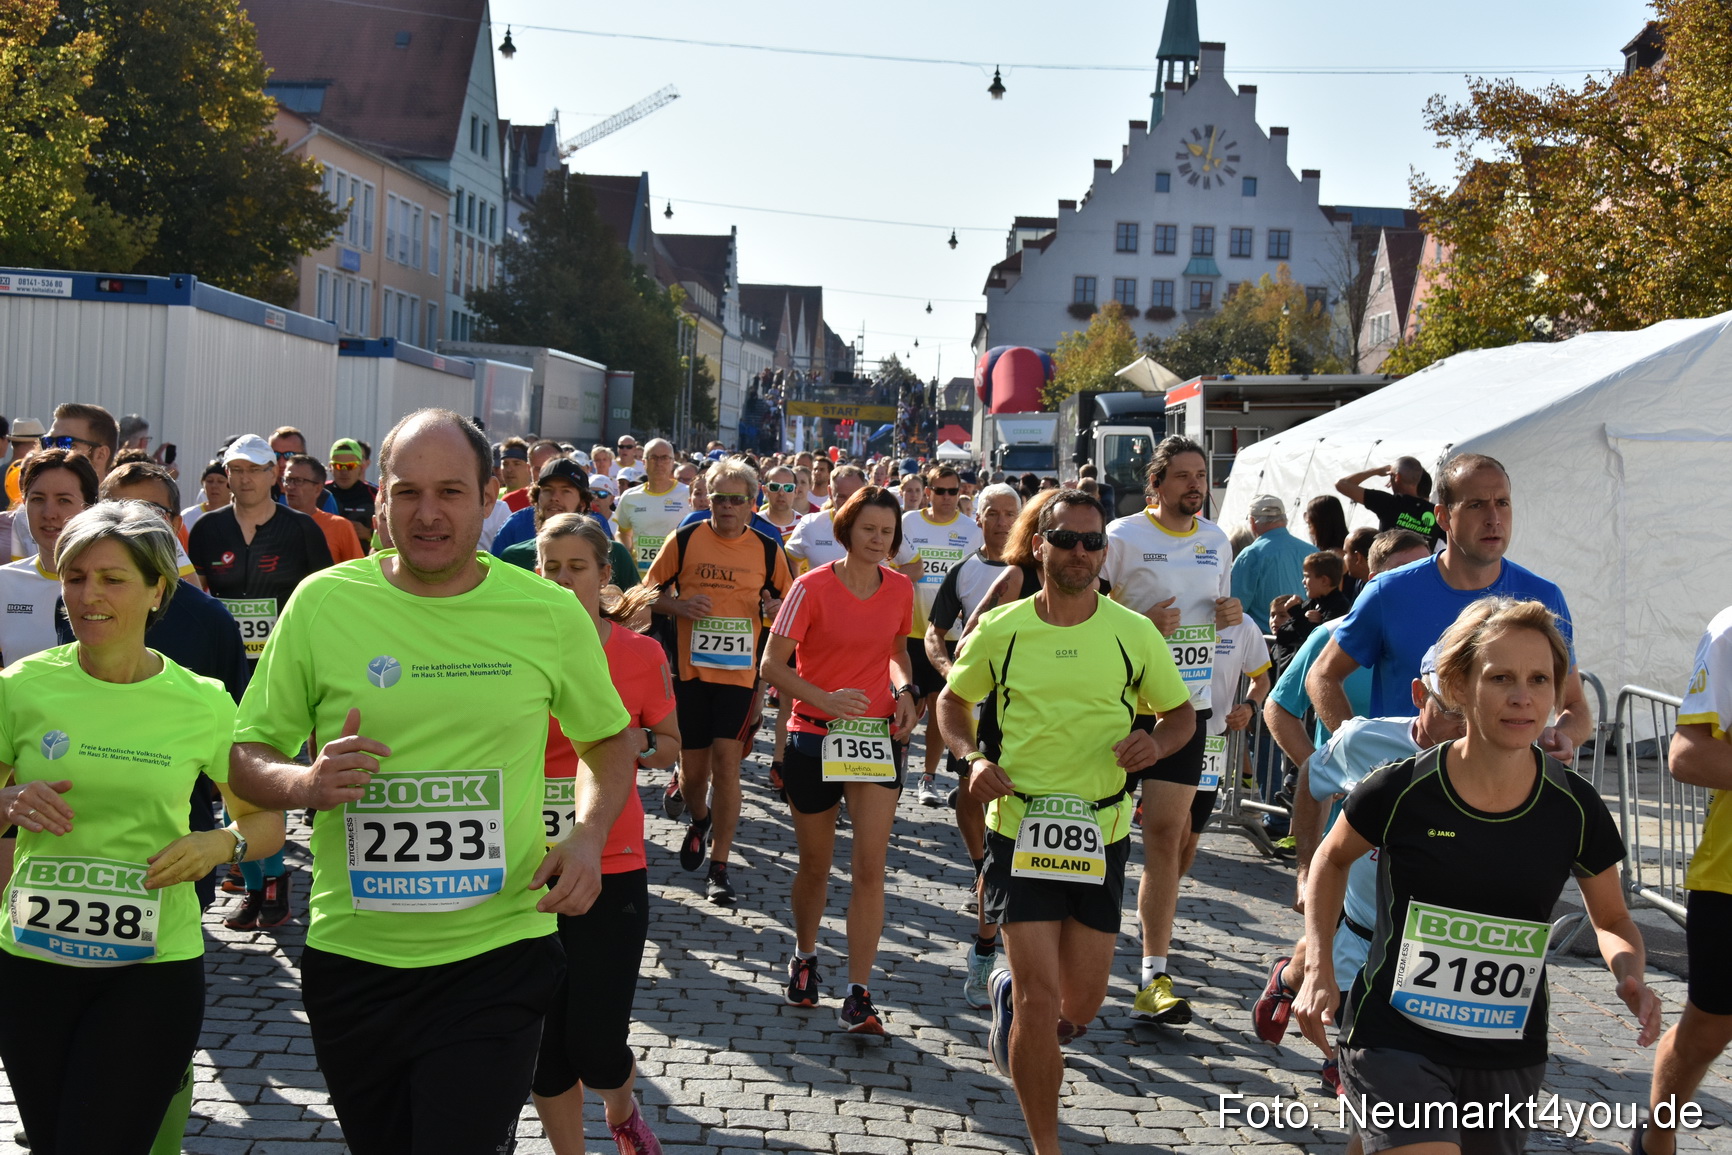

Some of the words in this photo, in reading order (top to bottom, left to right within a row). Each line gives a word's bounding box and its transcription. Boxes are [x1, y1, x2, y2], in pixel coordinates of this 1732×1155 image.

[822, 406, 860, 417] START
[1396, 519, 1431, 535] neumarkt
[641, 548, 660, 560] 26
[921, 549, 961, 558] BOCK
[701, 568, 736, 582] OEXL
[923, 561, 951, 574] 264
[226, 603, 269, 614] OCK
[236, 620, 270, 638] 39
[699, 619, 747, 632] BOCK
[1166, 627, 1210, 641] OCK
[698, 634, 745, 652] 2751
[430, 663, 471, 671] katholische
[470, 669, 513, 677] Neumarkt/Opf.
[80, 743, 97, 751] Freie
[98, 745, 136, 755] katholische
[136, 750, 172, 761] Volksschule
[832, 738, 885, 760] 1365
[110, 754, 131, 762] Marien,
[132, 756, 171, 767] Neumarkt/Opf.
[358, 777, 487, 807] BOCK
[363, 819, 486, 862] 2233
[1028, 823, 1098, 853] 1089
[1437, 830, 1456, 838] JAKO
[1031, 856, 1091, 872] ROLAND
[27, 862, 146, 893] BOCK
[363, 875, 490, 894] CHRISTIAN
[27, 896, 142, 940] 2238
[1417, 911, 1536, 952] BOCK
[48, 937, 119, 959] PETRA
[1413, 951, 1526, 998] 2180
[1404, 998, 1517, 1025] CHRISTINE
